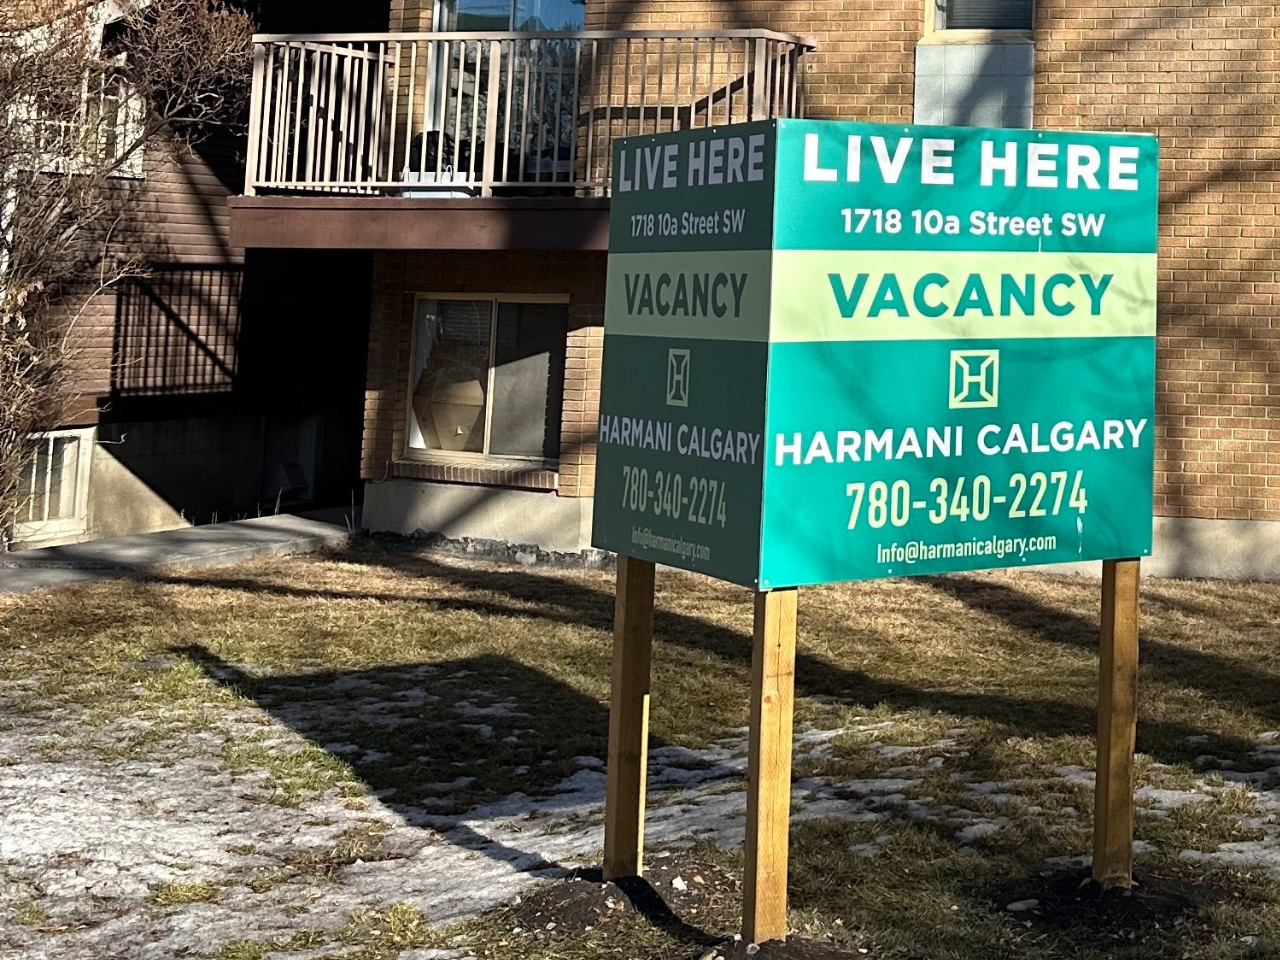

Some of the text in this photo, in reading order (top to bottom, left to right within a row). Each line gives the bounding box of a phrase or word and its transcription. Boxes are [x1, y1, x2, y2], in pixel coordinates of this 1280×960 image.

[619, 133, 765, 192] LIVE HERE
[803, 132, 1140, 191] LIVE HERE
[631, 208, 746, 237] 1718 10a Street SW
[840, 208, 1106, 238] 1718 10a Street SW
[624, 272, 748, 318] VACANCY
[828, 272, 1114, 318] VACANCY
[600, 414, 760, 465] HARMANI CALGARY
[774, 418, 1148, 466] HARMANI CALGARY
[622, 465, 727, 528] 780-340-2274
[846, 469, 1088, 530] 780-340-2274
[876, 533, 1057, 564] Info@harmanicalgary.com
